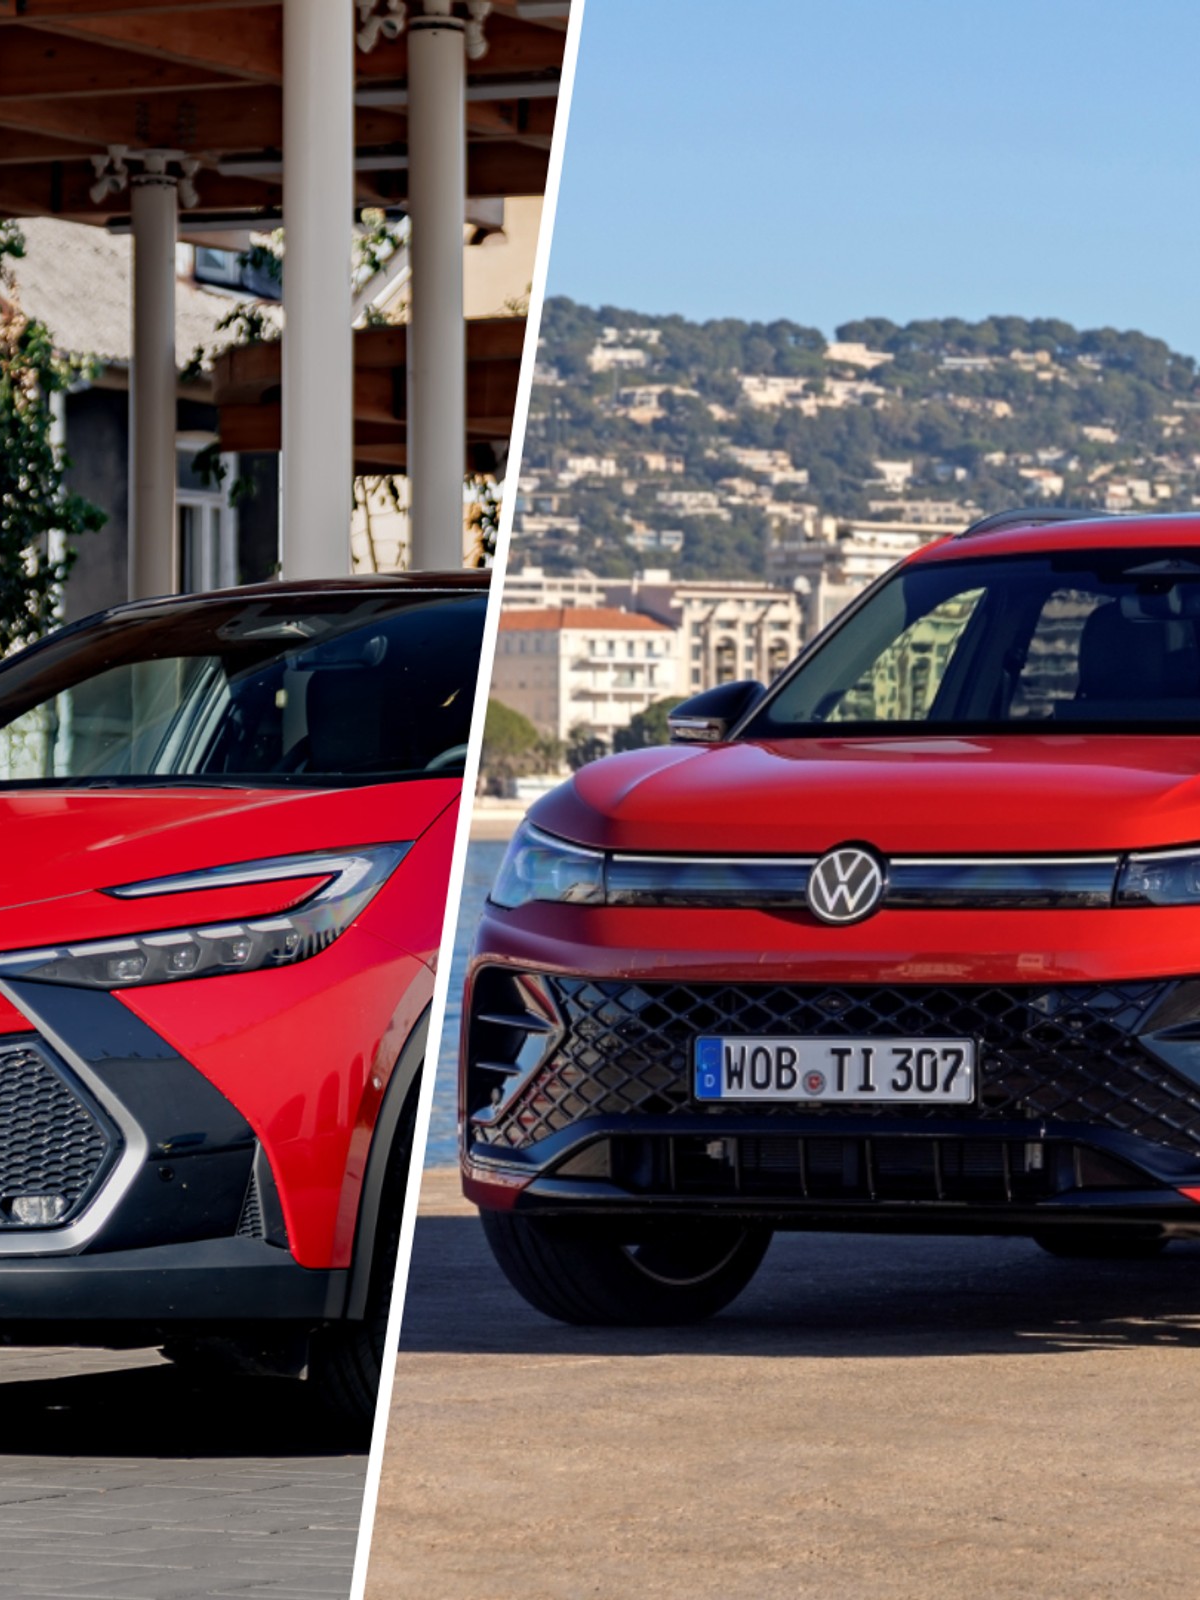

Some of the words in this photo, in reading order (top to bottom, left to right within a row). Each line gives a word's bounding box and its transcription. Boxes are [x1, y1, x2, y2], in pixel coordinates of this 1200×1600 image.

[704, 1073, 715, 1088] D
[725, 1045, 798, 1091] WOB
[891, 1047, 965, 1093] 307
